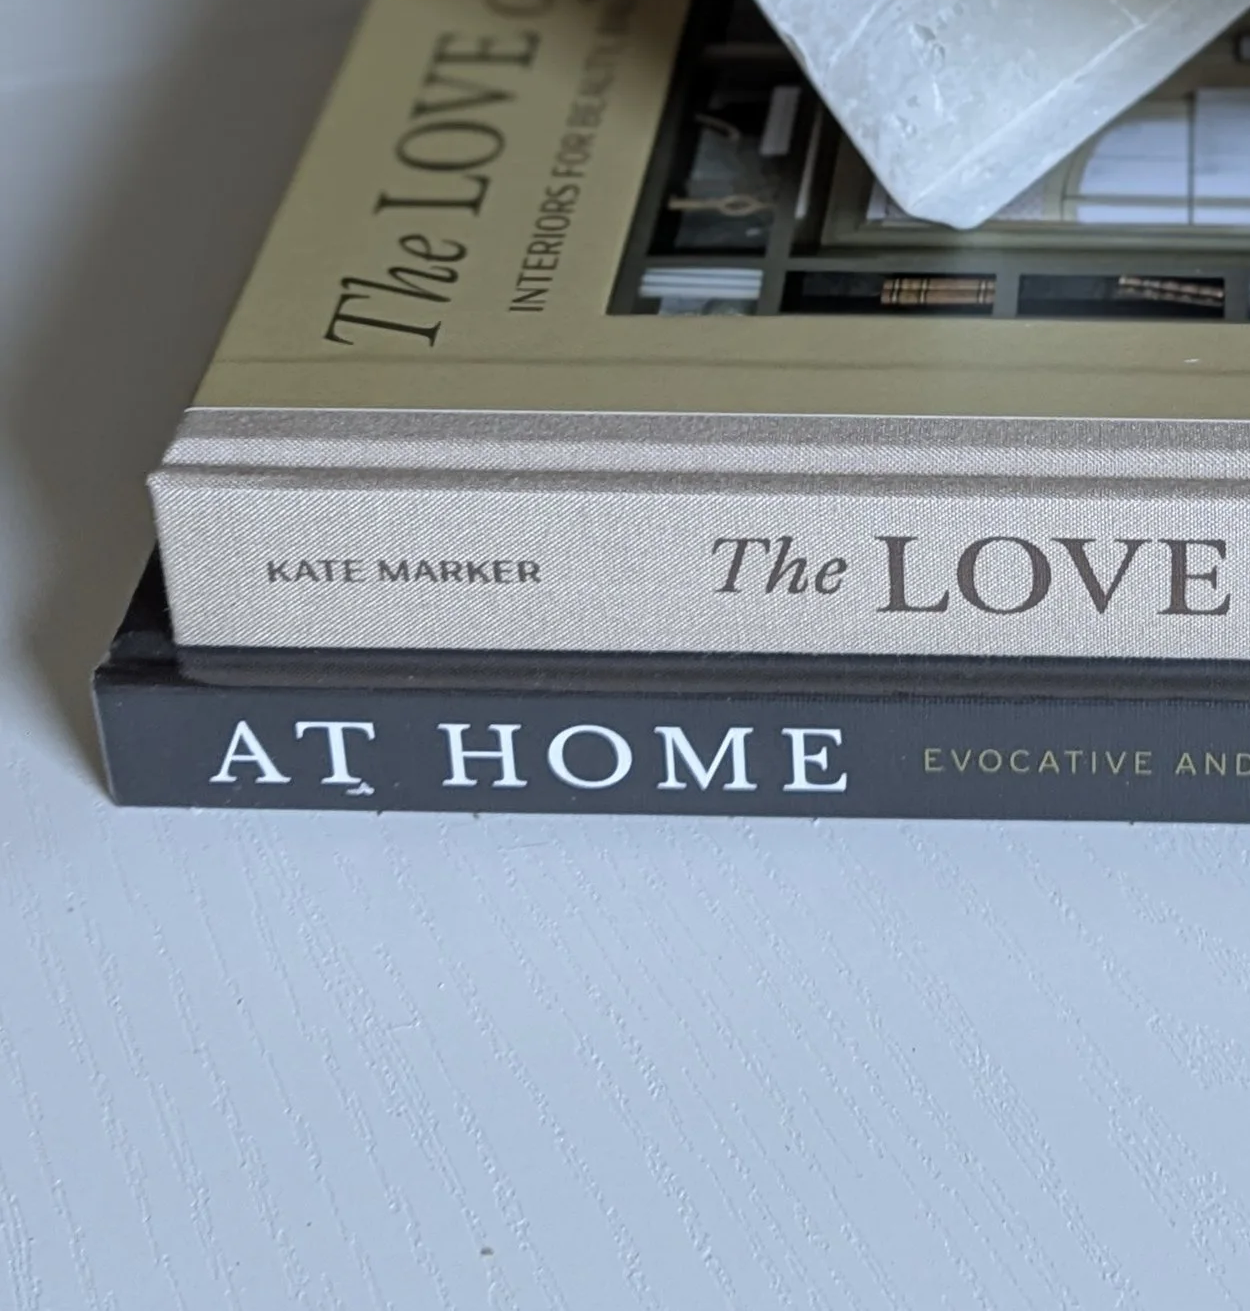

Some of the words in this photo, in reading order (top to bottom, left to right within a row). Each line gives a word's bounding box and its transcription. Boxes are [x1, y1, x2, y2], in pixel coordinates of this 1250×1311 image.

[371, 30, 542, 218] LOVE
[508, 180, 582, 314] INTERIORS
[551, 129, 598, 180] FOR
[323, 232, 468, 347] The
[267, 558, 362, 584] KATE
[377, 558, 542, 585] MARKER
[710, 534, 849, 596] The
[874, 534, 1232, 617] LOVE
[209, 719, 376, 785] AT
[437, 722, 848, 792] HOME
[923, 747, 1153, 776] EVOCATIVE
